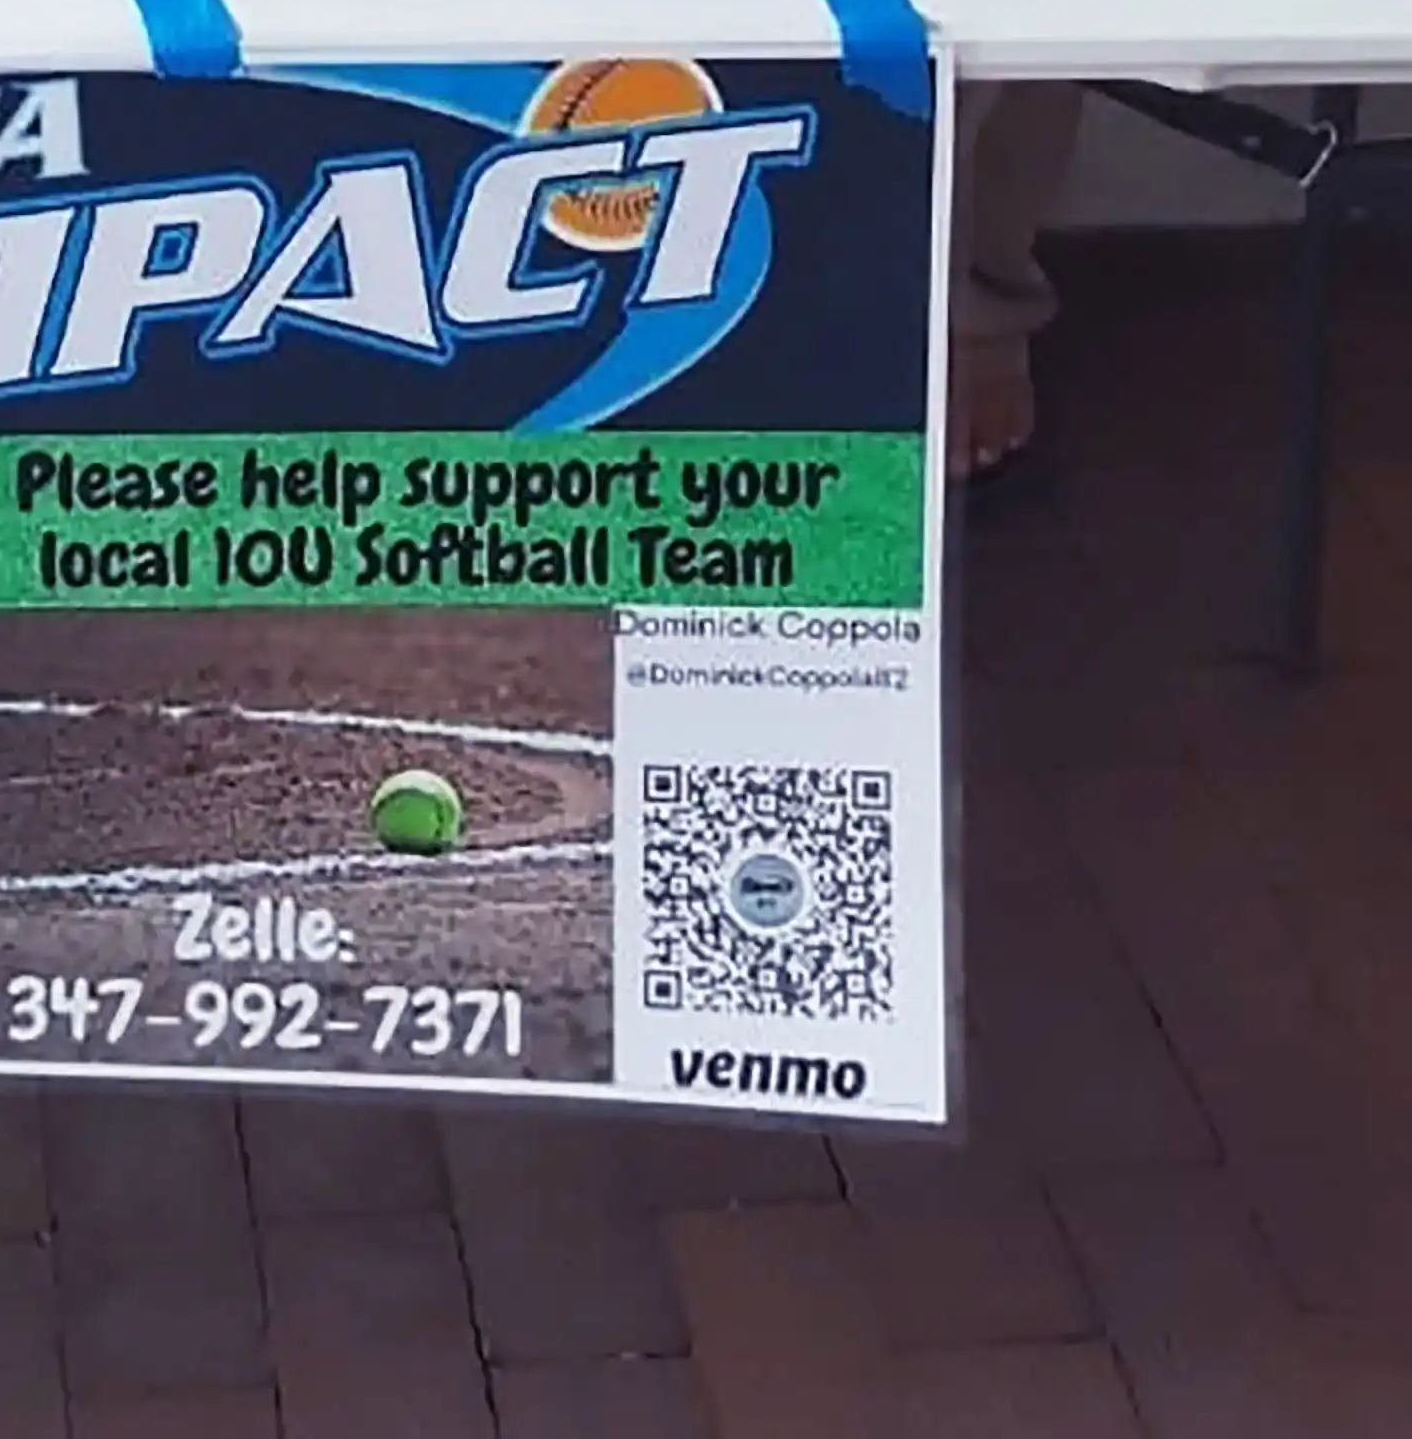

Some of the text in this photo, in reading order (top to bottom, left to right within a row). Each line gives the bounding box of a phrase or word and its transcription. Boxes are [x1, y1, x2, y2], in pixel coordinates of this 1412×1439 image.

[16, 447, 841, 529] Please help support your
[39, 521, 796, 589] local 10U Softball Team
[614, 609, 922, 649] Dominick Coppola
[172, 892, 356, 964] Zelle:
[5, 974, 524, 1059] 347-992-7371
[670, 1048, 867, 1101] venmo
